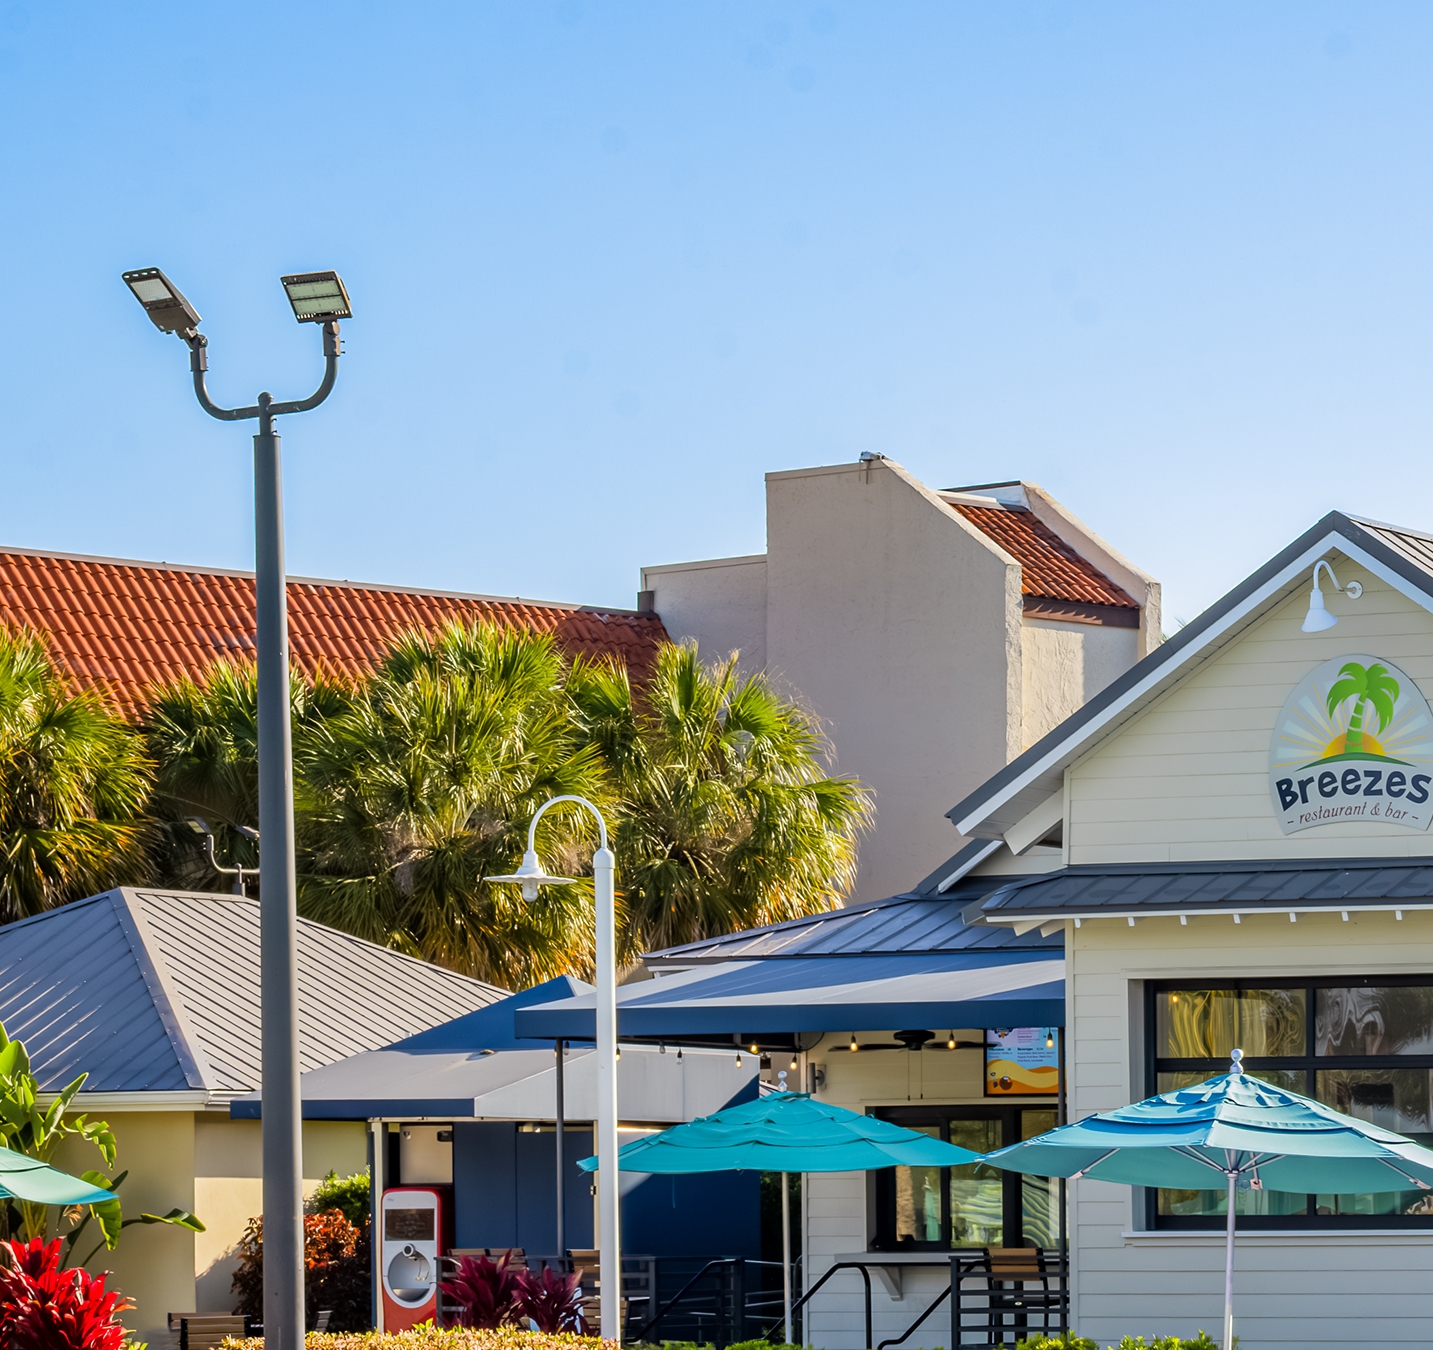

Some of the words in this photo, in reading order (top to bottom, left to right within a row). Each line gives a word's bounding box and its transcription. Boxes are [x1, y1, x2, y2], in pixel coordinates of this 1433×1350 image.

[1275, 768, 1433, 812] Breezes
[1299, 801, 1367, 824] restaurant
[1370, 802, 1381, 816] &
[1384, 801, 1409, 820] bar
